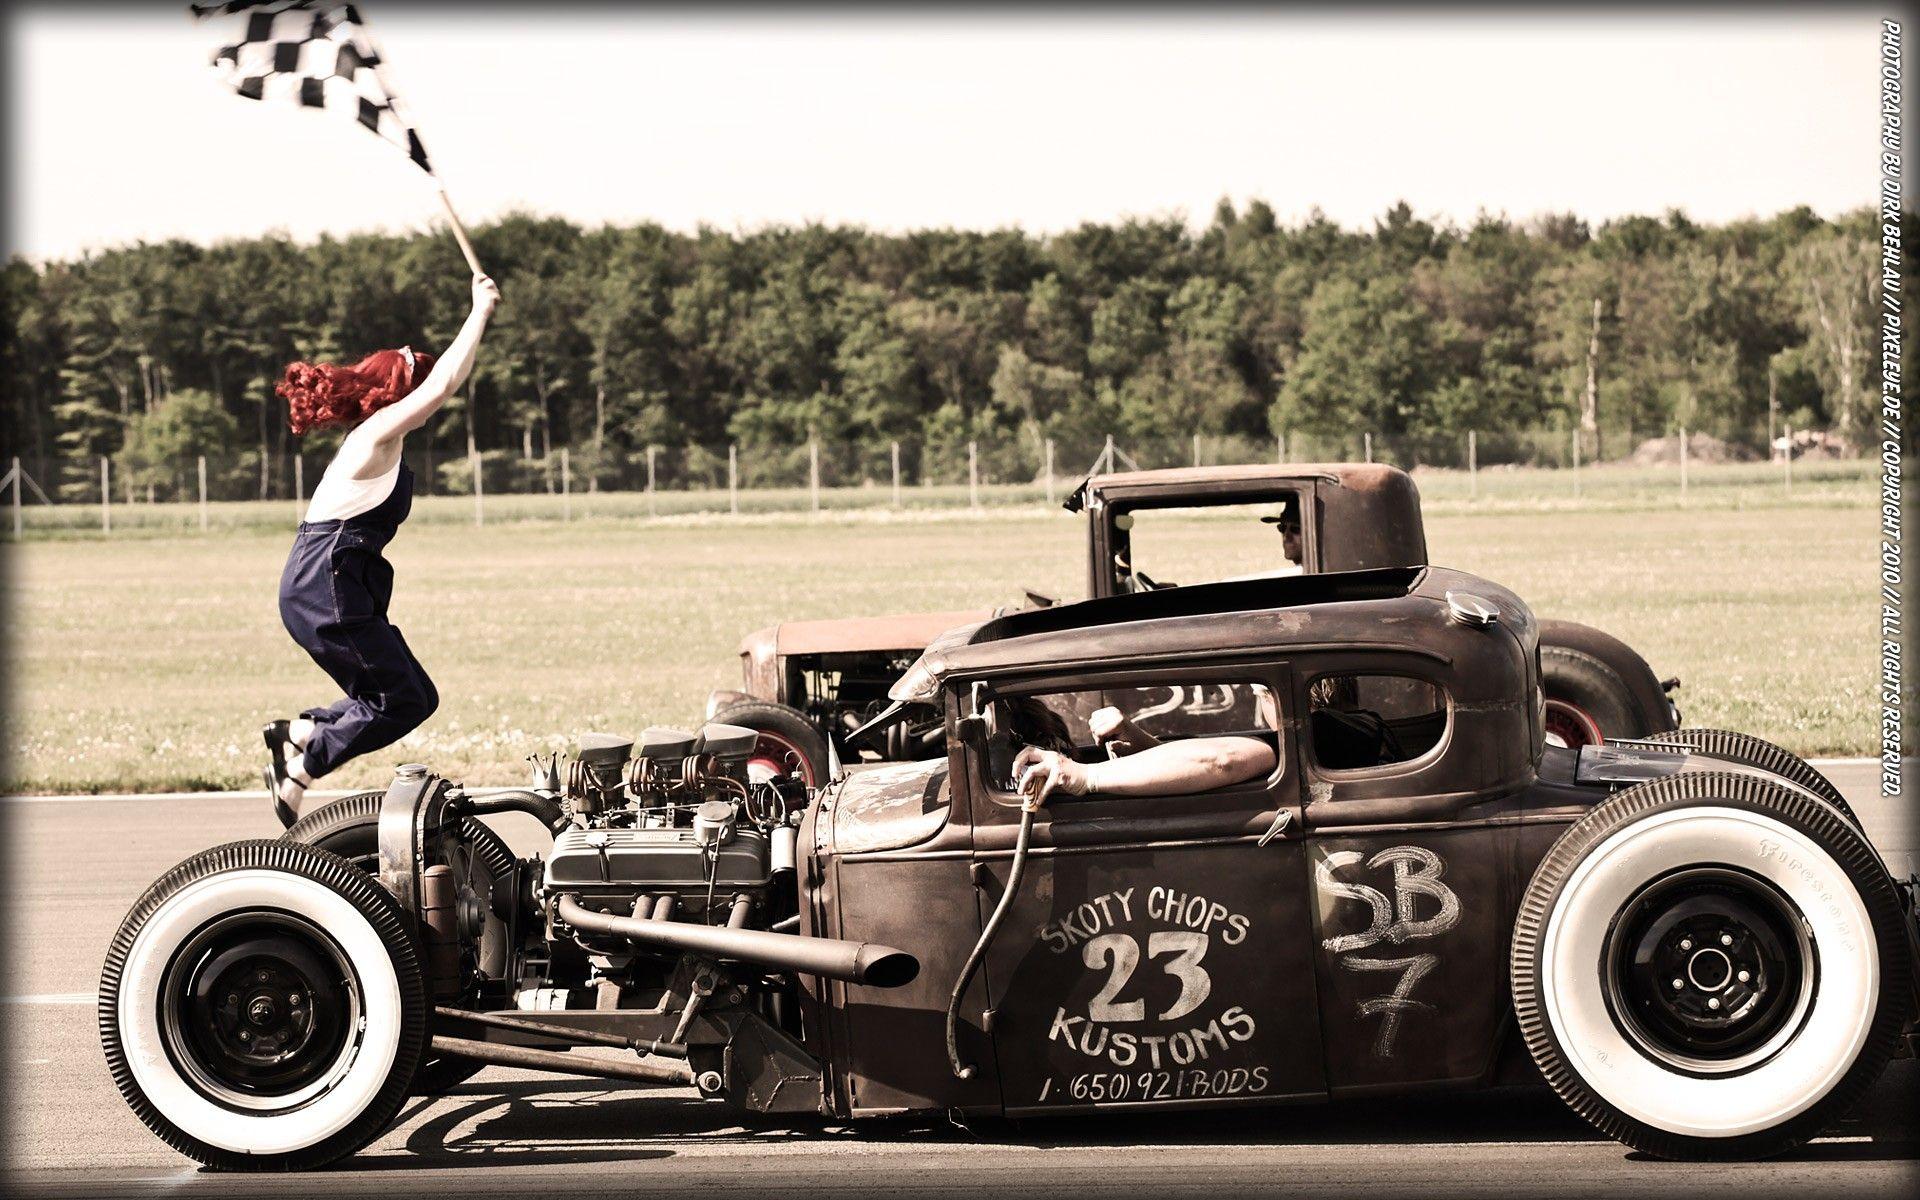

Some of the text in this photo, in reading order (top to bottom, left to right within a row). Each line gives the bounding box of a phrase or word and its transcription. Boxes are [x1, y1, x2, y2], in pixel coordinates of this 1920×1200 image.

[1040, 885, 1252, 955] SKOTY CHOPS
[1314, 845, 1463, 953] SB
[1082, 931, 1212, 1022] 23
[1340, 953, 1443, 1057] 7
[1048, 1005, 1256, 1070] KUSTOMS
